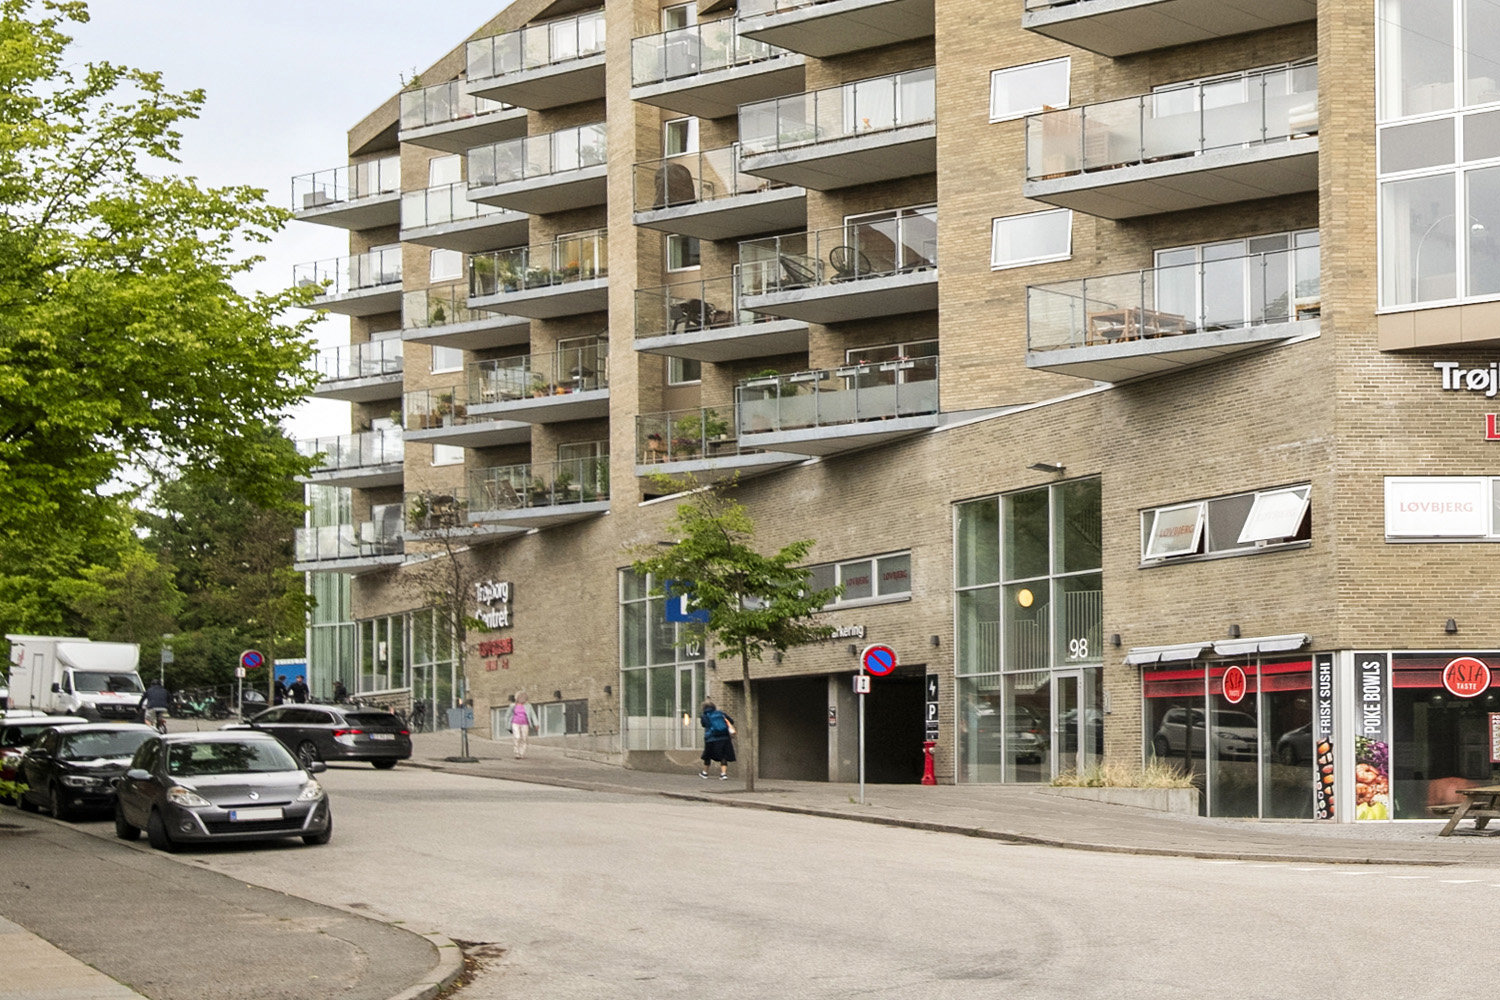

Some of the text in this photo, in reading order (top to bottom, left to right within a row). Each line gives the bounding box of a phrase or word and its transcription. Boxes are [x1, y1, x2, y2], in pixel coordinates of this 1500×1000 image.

[1400, 501, 1474, 514] LØVBJERG
[1070, 638, 1088, 659] 98
[1446, 664, 1483, 684] ASIA
[1319, 662, 1331, 734] FRISK SUSHI
[1362, 661, 1381, 734] POKE BOWLS
[929, 704, 936, 720] P
